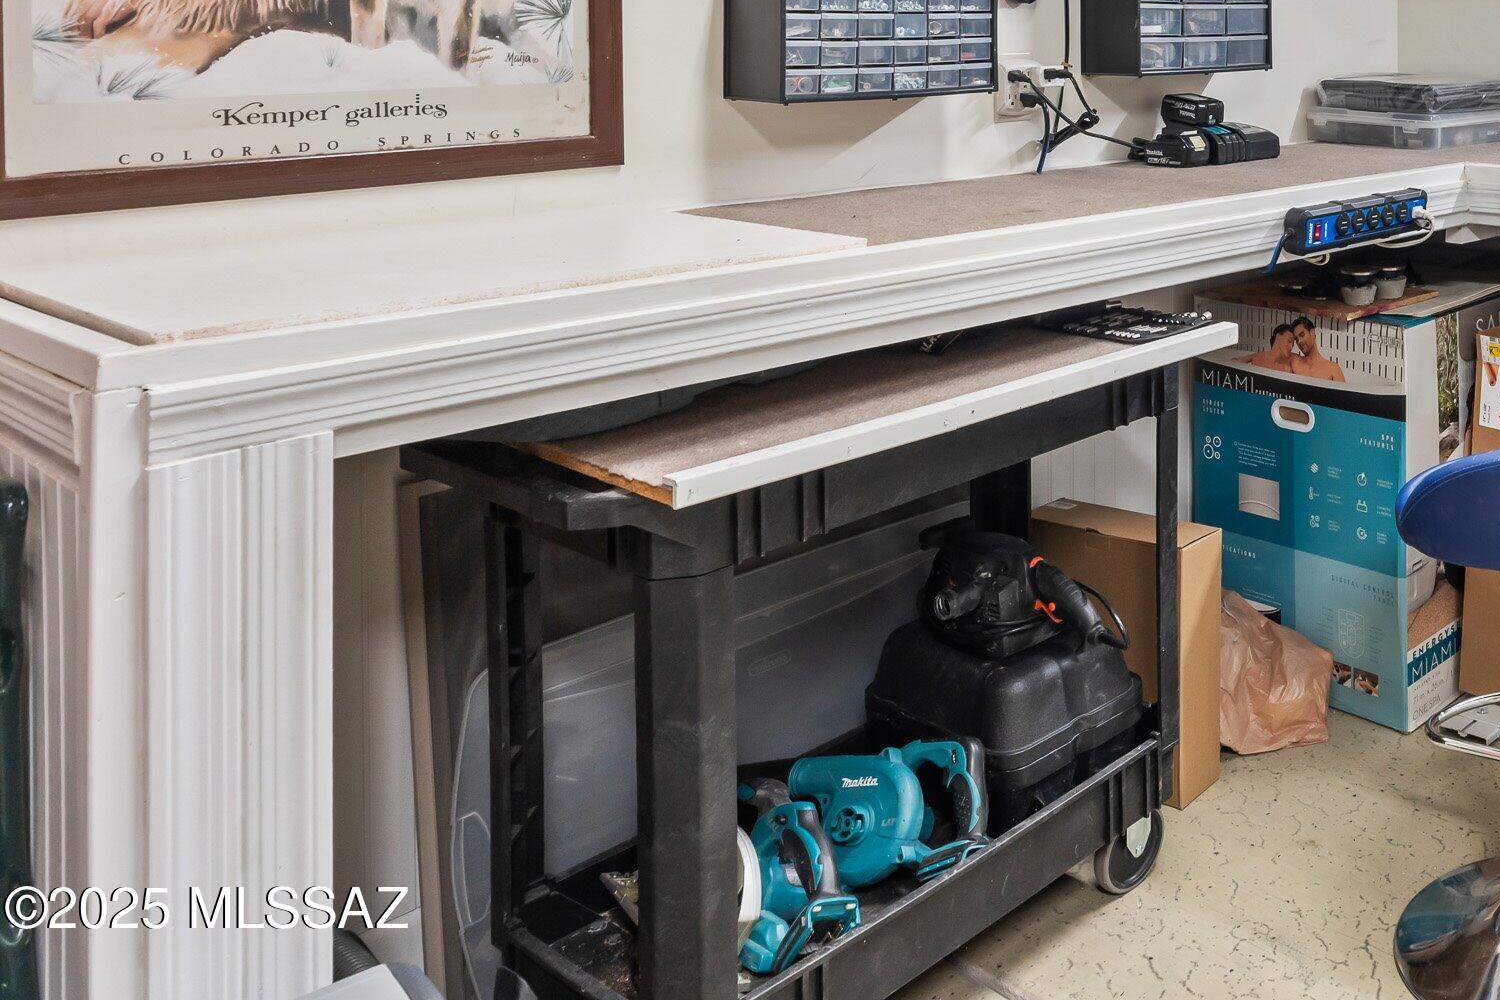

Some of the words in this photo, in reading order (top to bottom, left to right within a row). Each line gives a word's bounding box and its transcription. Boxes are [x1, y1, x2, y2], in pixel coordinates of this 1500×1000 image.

[212, 101, 340, 128] Kemper
[345, 93, 449, 127] galleries
[118, 138, 340, 166] COLORADO
[378, 128, 521, 148] SPRINGS
[1202, 368, 1254, 394] MIAMI
[1360, 438, 1394, 451] FEATURES
[1412, 637, 1457, 684] MIAMI
